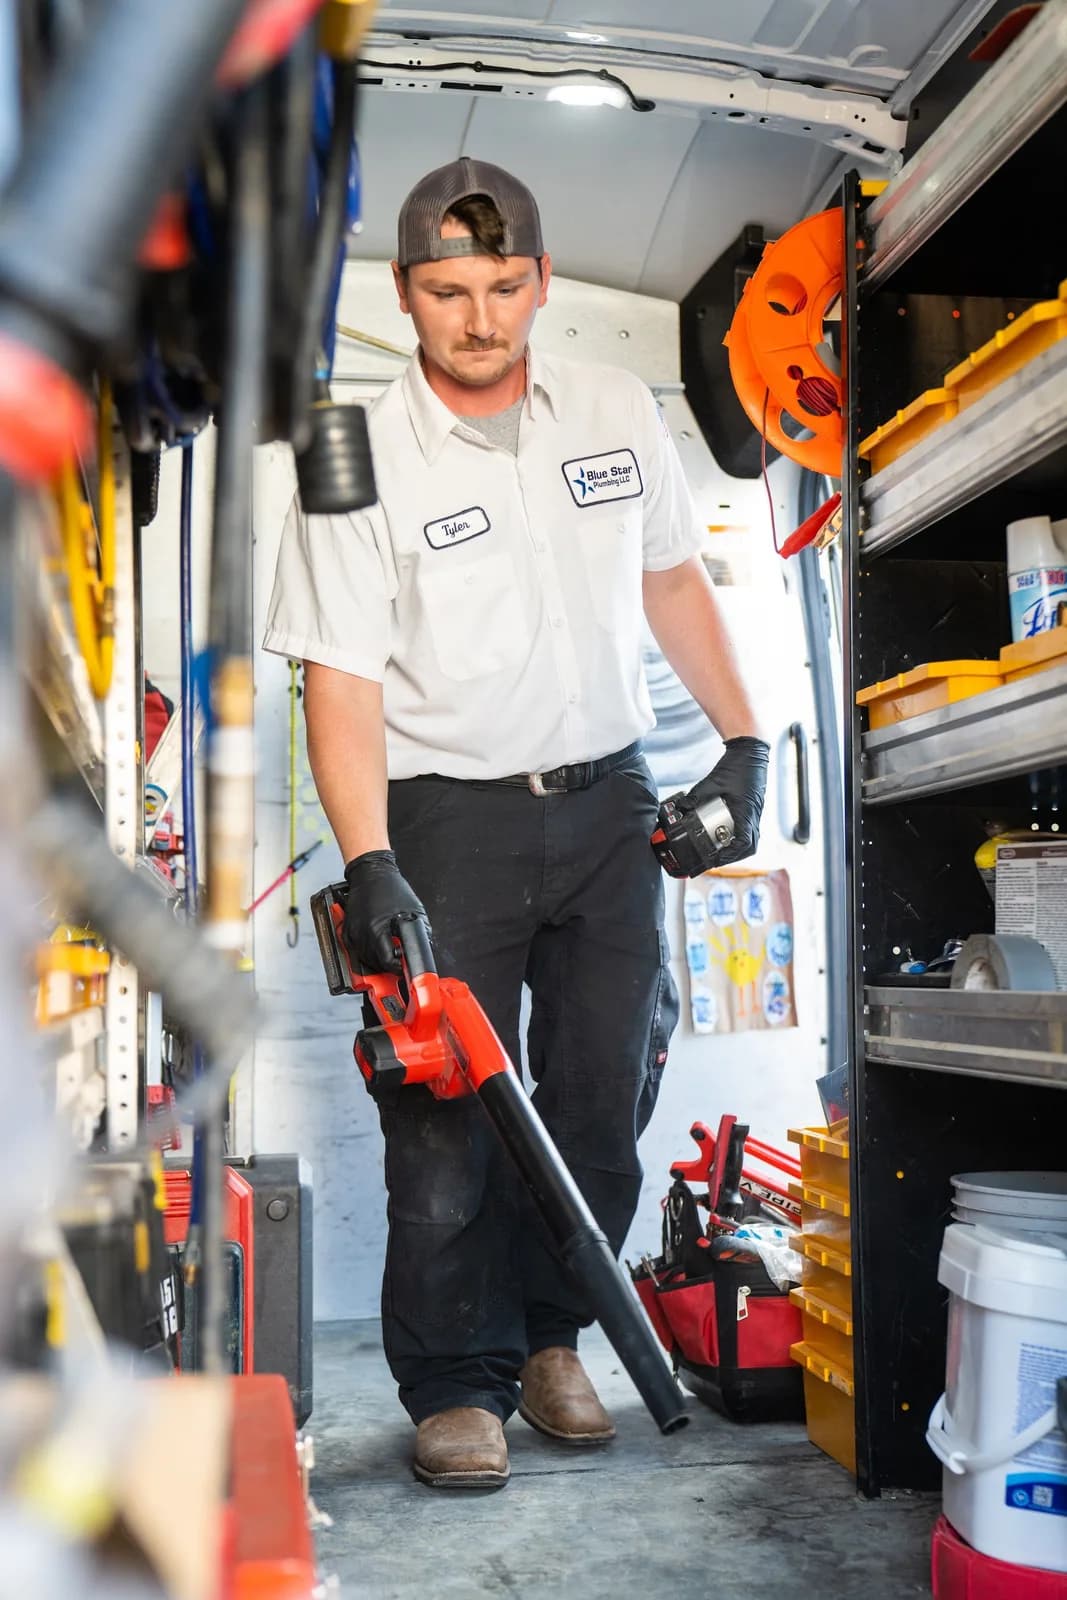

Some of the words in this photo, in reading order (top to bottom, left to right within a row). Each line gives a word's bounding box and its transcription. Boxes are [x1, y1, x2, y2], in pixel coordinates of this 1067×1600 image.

[587, 468, 608, 481] Blue
[610, 465, 633, 478] Star
[593, 478, 619, 488] Plumbing
[619, 475, 631, 484] LLC
[441, 521, 470, 538] Tyler
